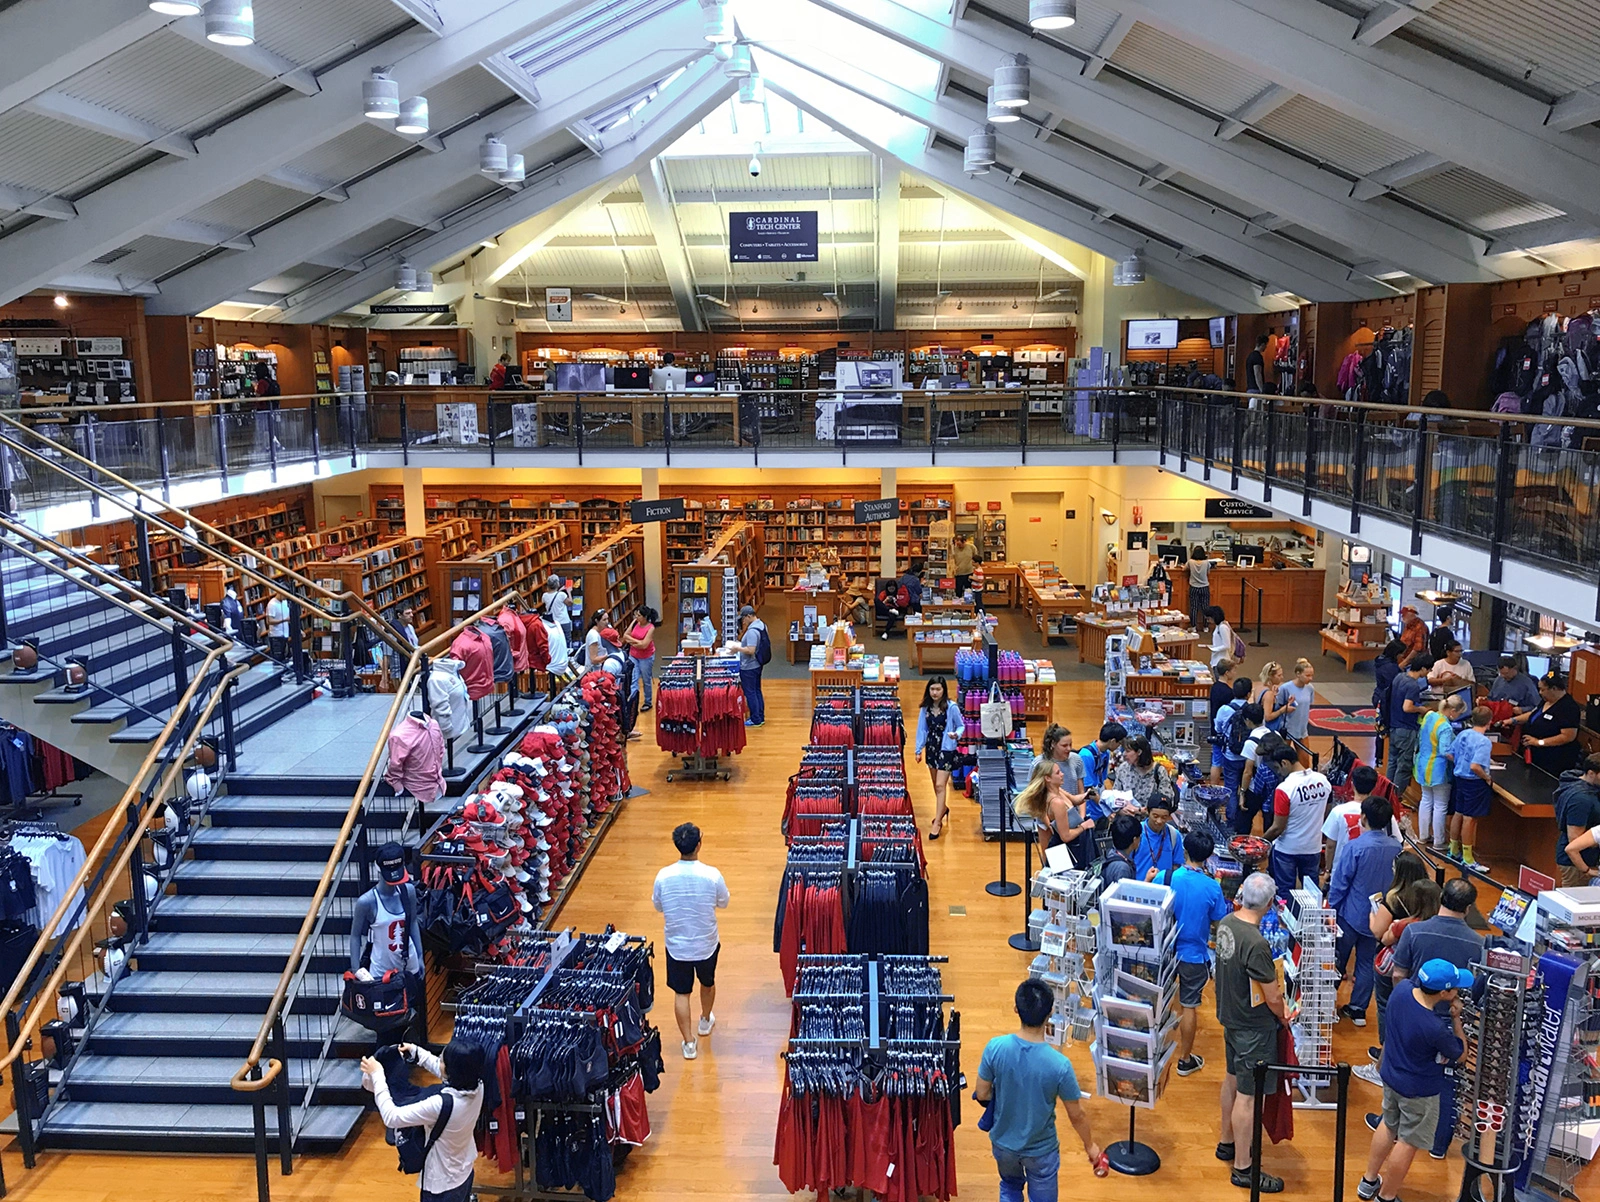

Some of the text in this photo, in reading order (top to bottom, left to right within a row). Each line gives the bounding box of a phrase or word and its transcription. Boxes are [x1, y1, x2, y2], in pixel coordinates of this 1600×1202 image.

[863, 502, 892, 512] STANFORD
[1219, 499, 1253, 508] CUSTO
[645, 507, 671, 516] FICTION
[1223, 507, 1254, 515] SERVICE
[865, 511, 891, 521] AUTHORS
[1492, 909, 1517, 926] WHO
